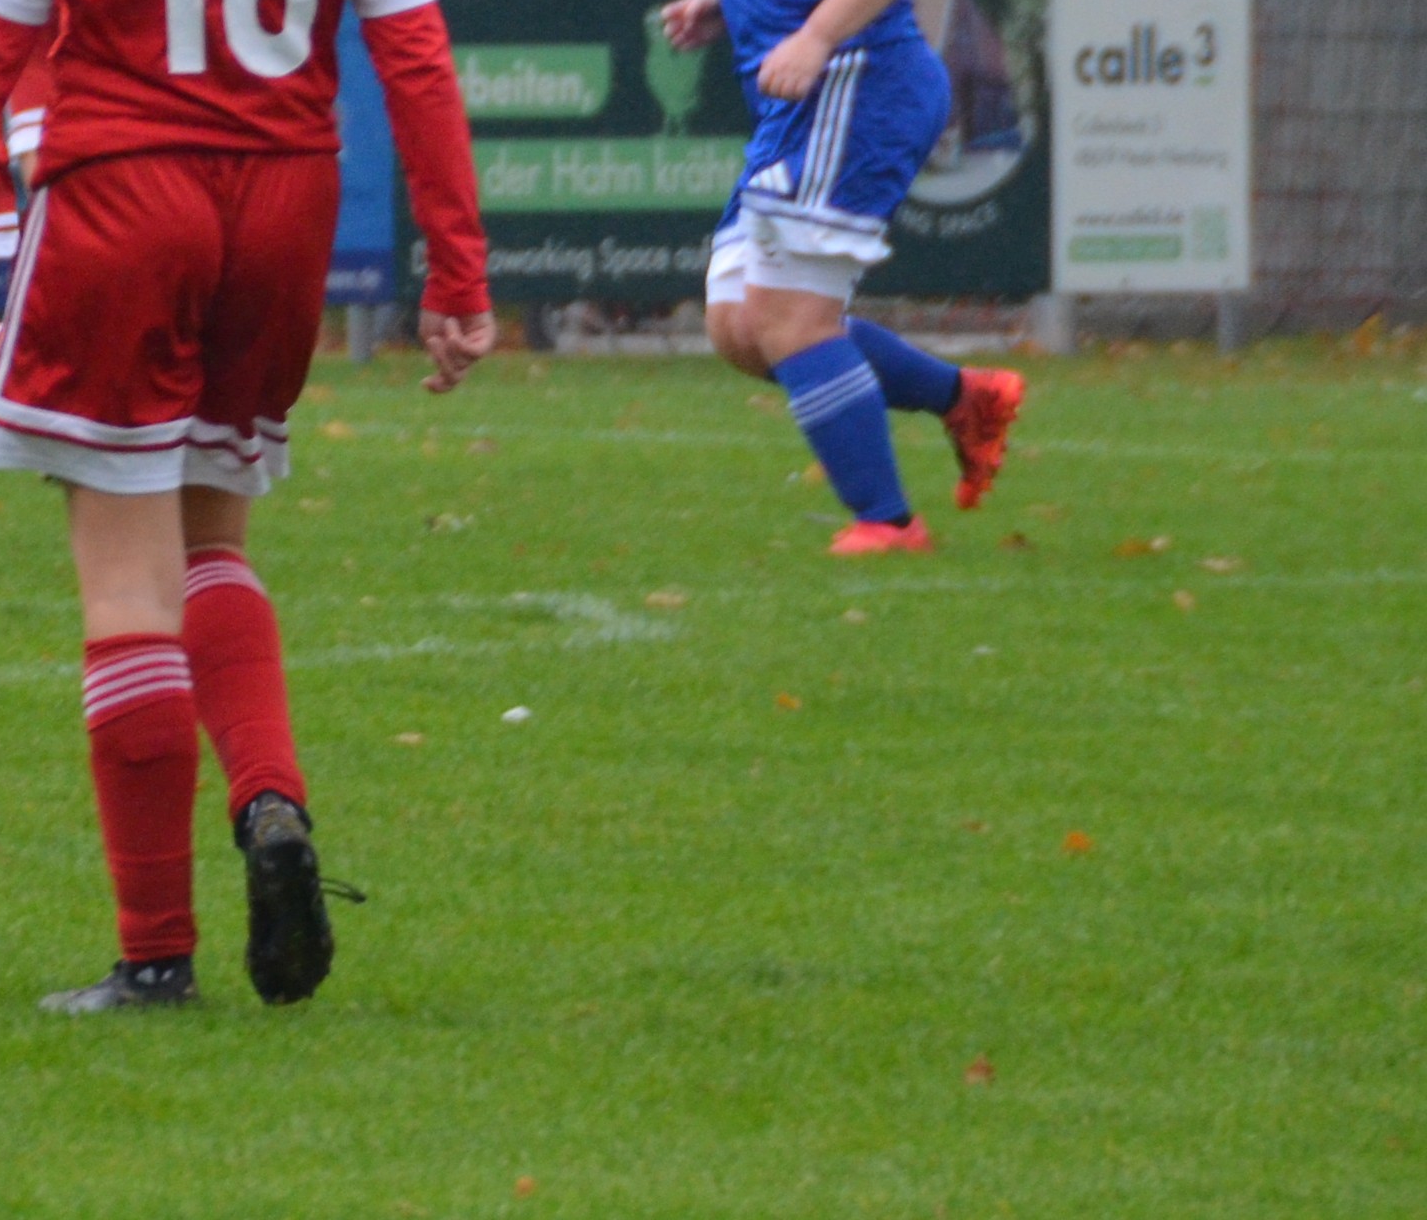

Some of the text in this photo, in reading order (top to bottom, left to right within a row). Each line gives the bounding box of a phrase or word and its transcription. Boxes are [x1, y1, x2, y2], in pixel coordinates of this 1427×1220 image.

[1074, 23, 1186, 87] calle
[485, 144, 541, 196] der
[553, 144, 643, 195] Hahn
